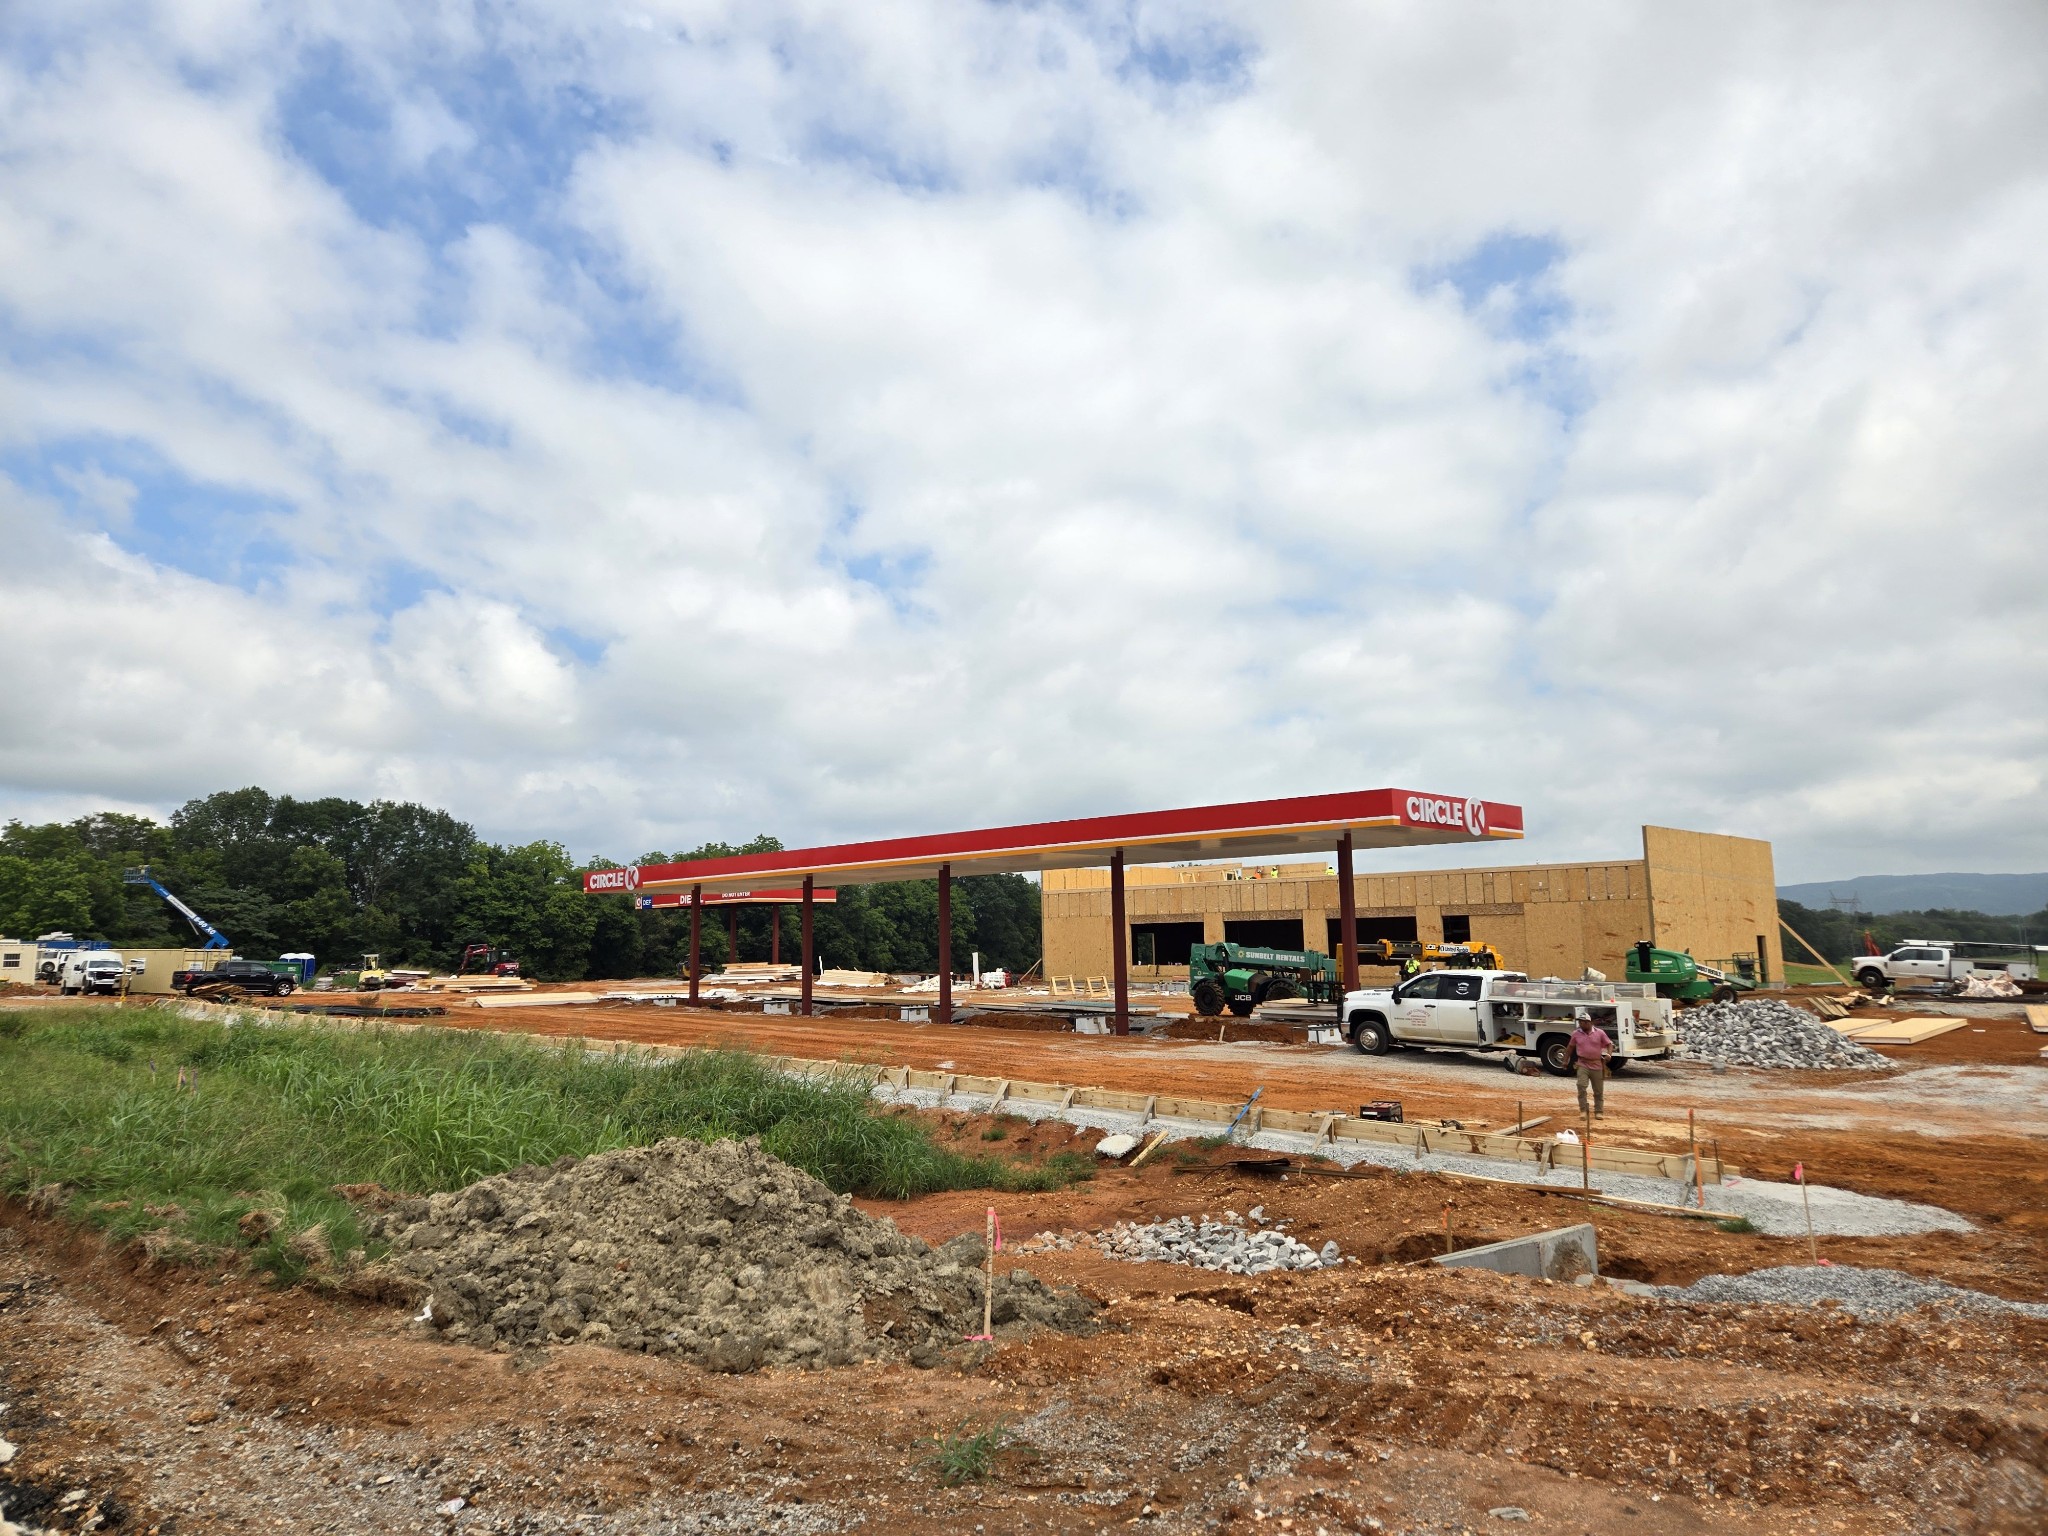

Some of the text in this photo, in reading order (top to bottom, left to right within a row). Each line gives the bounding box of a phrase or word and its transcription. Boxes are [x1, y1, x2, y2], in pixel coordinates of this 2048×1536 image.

[1406, 796, 1485, 835] CIRCLE K
[589, 867, 639, 889] CIRCLE K
[680, 894, 704, 904] DIEL
[1246, 952, 1305, 962] SUNBELT RENTALS
